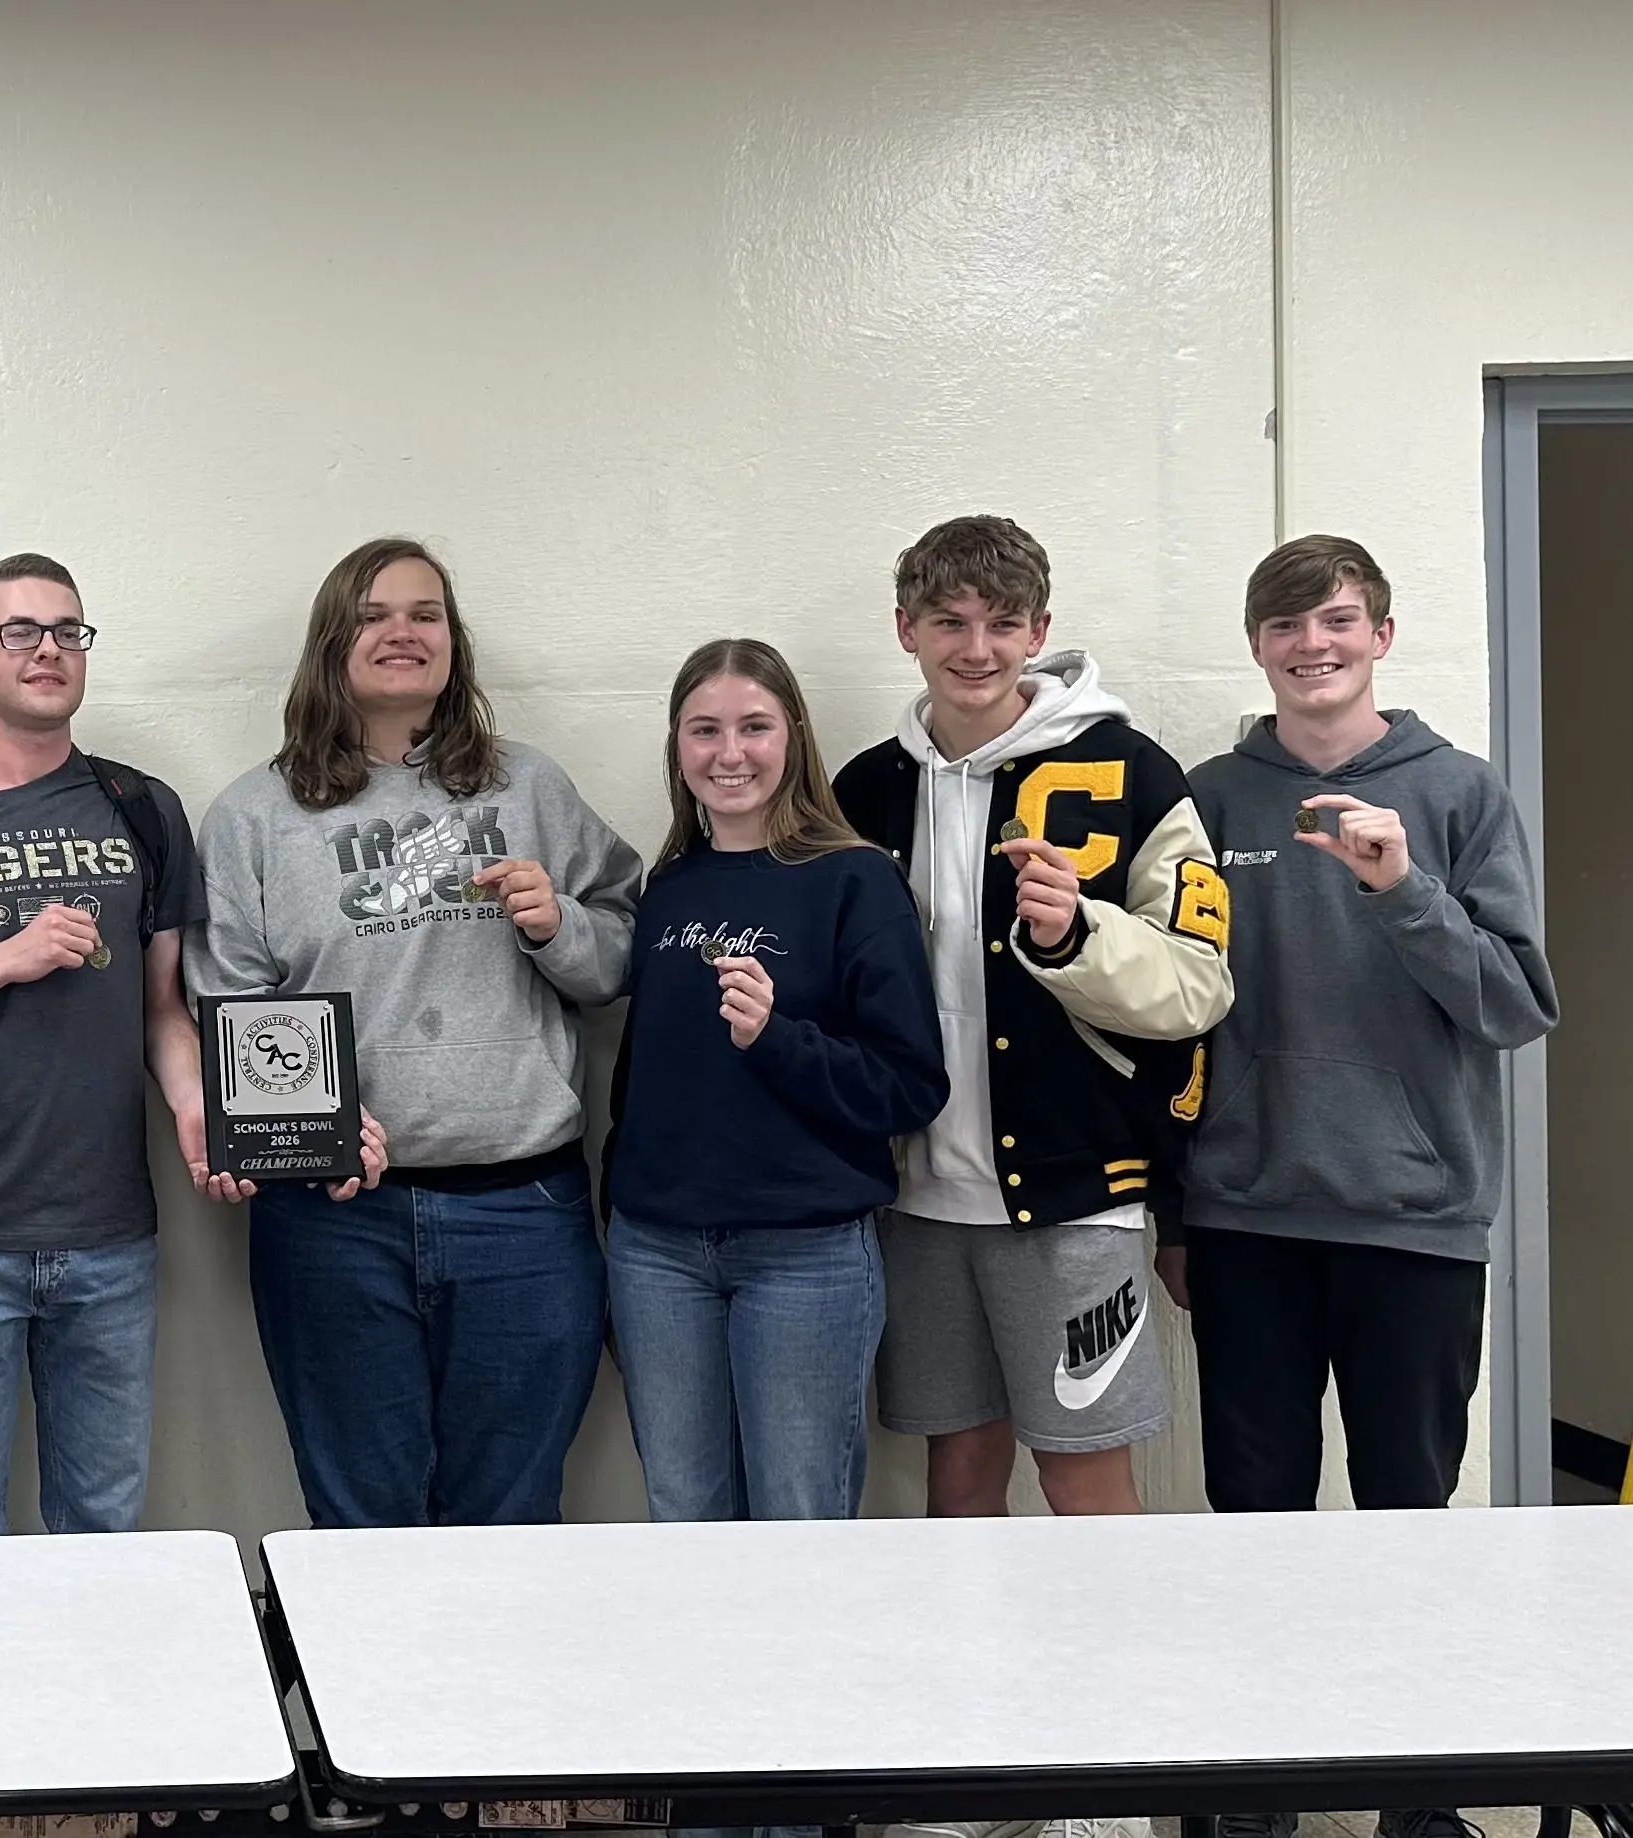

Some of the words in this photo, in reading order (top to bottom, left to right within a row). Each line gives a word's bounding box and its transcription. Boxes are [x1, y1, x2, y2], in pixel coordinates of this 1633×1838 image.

[1015, 760, 1125, 880] C
[323, 806, 508, 875] TRACK
[1261, 850, 1278, 858] LIFE
[355, 920, 395, 937] CAIRO
[400, 908, 472, 931] BEARCATS
[477, 907, 508, 920] 202
[650, 925, 676, 952] be
[680, 921, 711, 949] the
[712, 921, 788, 957] light
[246, 1016, 293, 1040] ACTIVITIES
[255, 1034, 303, 1071] CAC
[291, 1036, 318, 1090] CONFERENCE
[240, 1056, 272, 1091] CENTRAL
[233, 1121, 298, 1134] SCHOLAR'S
[300, 1120, 335, 1132] BOWL
[270, 1135, 300, 1146] 2026
[240, 1155, 334, 1170] CHAMPIONS
[1066, 1276, 1140, 1369] NIKE
